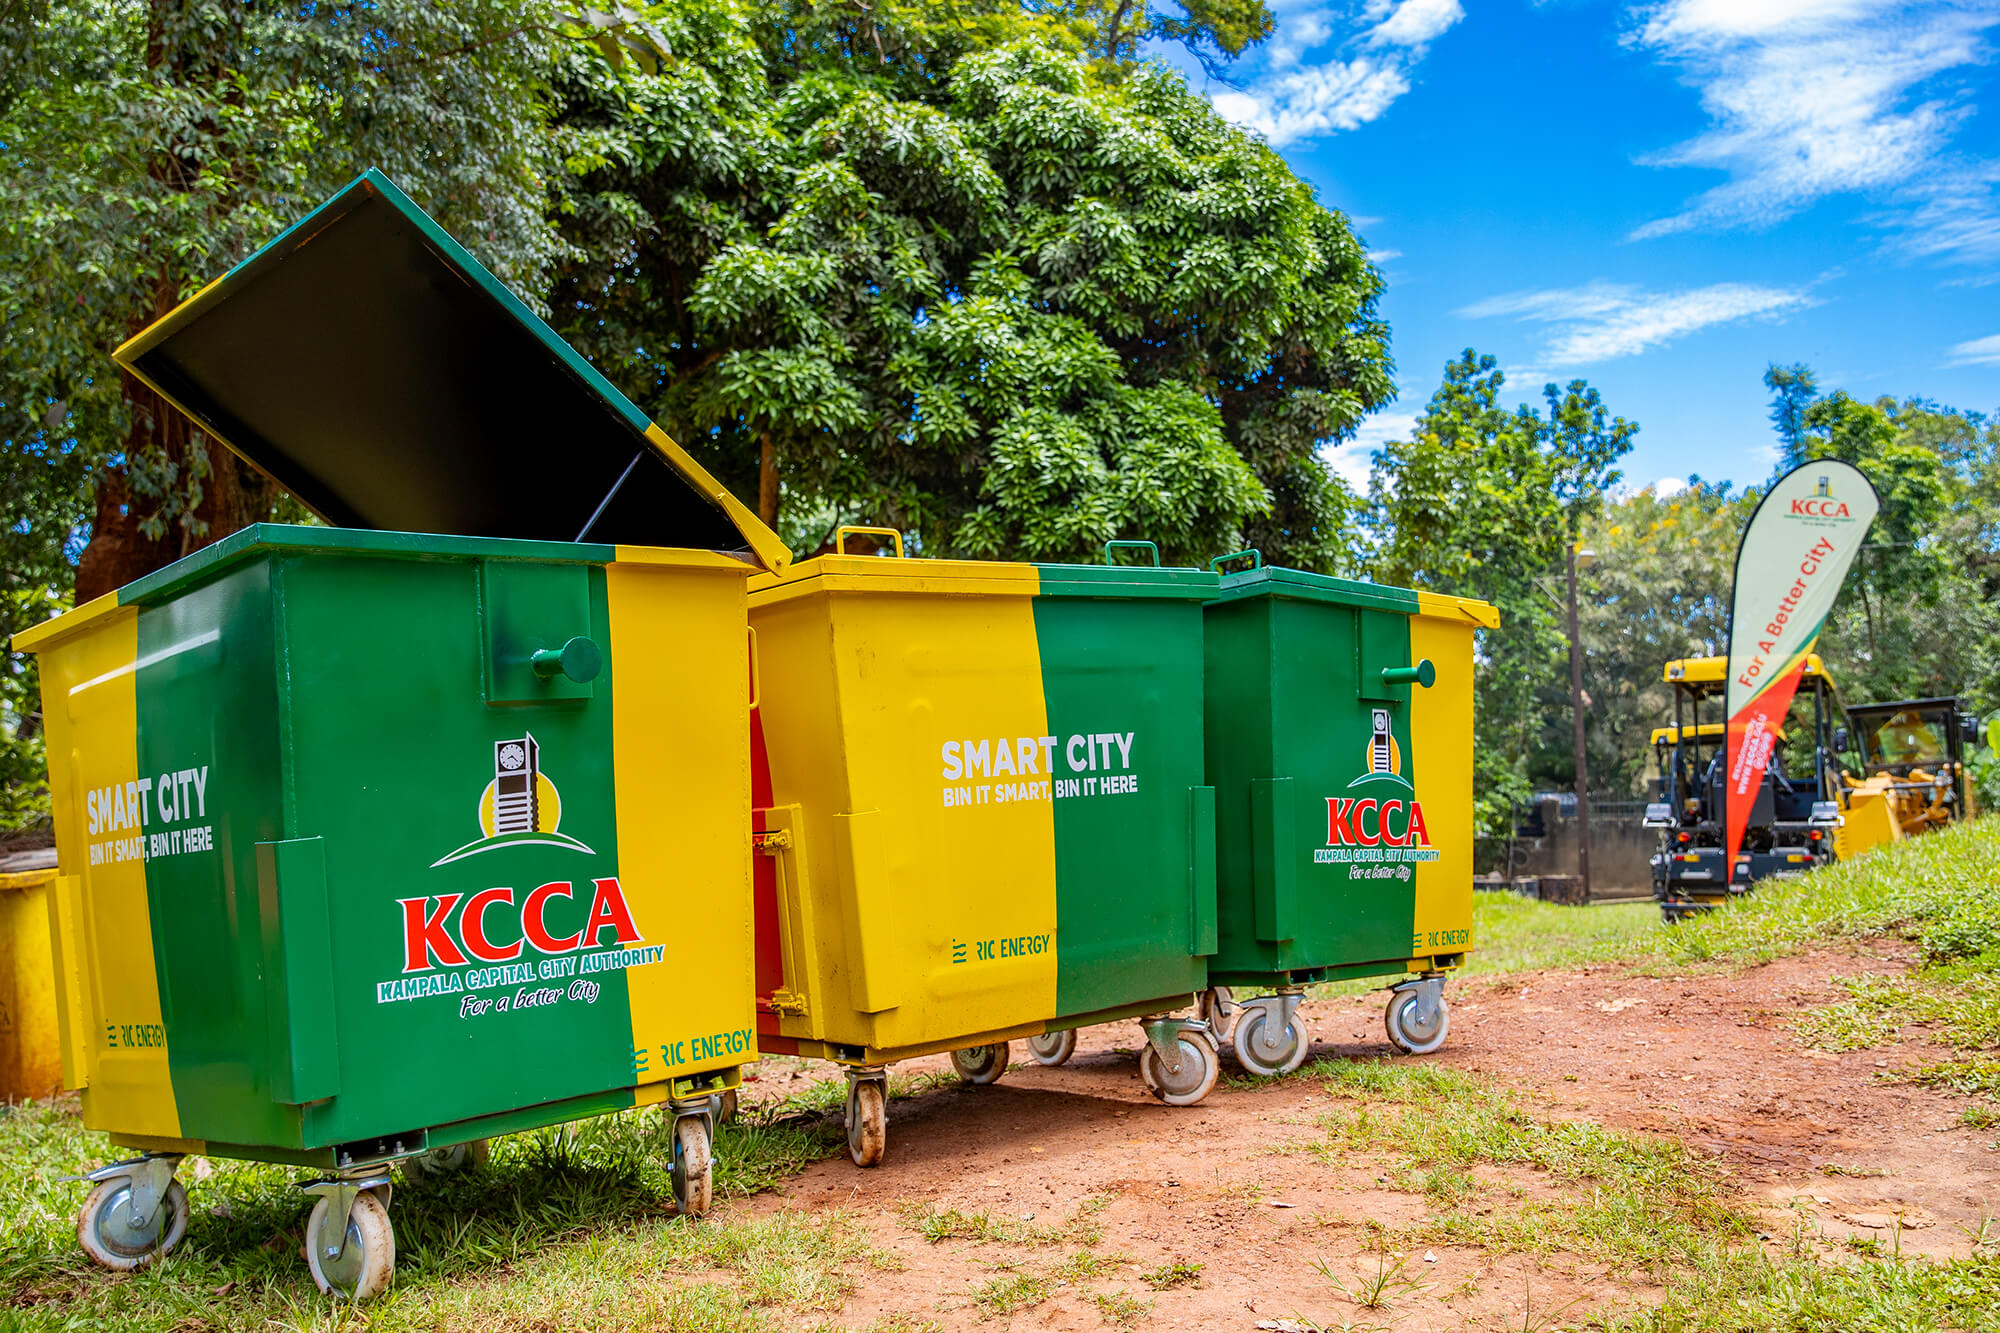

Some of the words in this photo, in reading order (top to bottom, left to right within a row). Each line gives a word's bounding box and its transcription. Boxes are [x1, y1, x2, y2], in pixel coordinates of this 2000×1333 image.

[1791, 499, 1850, 517] KCCA
[1801, 536, 1835, 576] City
[1766, 578, 1807, 637] Better
[1758, 640, 1775, 654] A
[1739, 656, 1765, 687] For
[941, 736, 1058, 780] SMART
[1066, 732, 1135, 772] CITY
[87, 778, 152, 835] SMART
[158, 766, 208, 823] CITY
[943, 786, 972, 807] BIN
[976, 785, 990, 804] IT
[995, 781, 1052, 803] SMART,
[1055, 778, 1080, 799] BIN
[1083, 777, 1097, 796] IT
[1100, 775, 1138, 795] HERE
[1325, 797, 1432, 847] KCCA
[90, 843, 104, 866] BIN
[105, 841, 113, 864] IT
[115, 836, 149, 863] SMART,
[150, 832, 169, 857] BIN
[171, 831, 181, 855] IT
[183, 826, 213, 853] HERE
[1314, 849, 1352, 863] KAMPALA
[1353, 849, 1384, 862] CAPITAL
[1385, 849, 1402, 862] CITY
[1403, 849, 1440, 862] AUTHORITY
[1349, 865, 1364, 880] For
[1364, 868, 1372, 879] a
[1372, 864, 1395, 879] better
[1396, 864, 1411, 882] City
[396, 877, 645, 973] KCCA
[1428, 931, 1439, 947] RIC
[1441, 929, 1470, 946] ENERGY
[976, 940, 996, 960] RIC
[1001, 934, 1050, 957] ENERGY
[377, 972, 464, 1003] KAMPALA
[465, 964, 537, 992] CAPITAL
[539, 956, 577, 980] CITY
[580, 944, 666, 974] AUTHORITY
[459, 996, 492, 1018] For
[496, 997, 508, 1012] a
[513, 986, 563, 1010] better
[567, 979, 600, 1003] City
[121, 1024, 135, 1047] RIC
[135, 1024, 166, 1047] ENERGY
[660, 1040, 686, 1067] RIC
[691, 1028, 753, 1063] ENERGY
